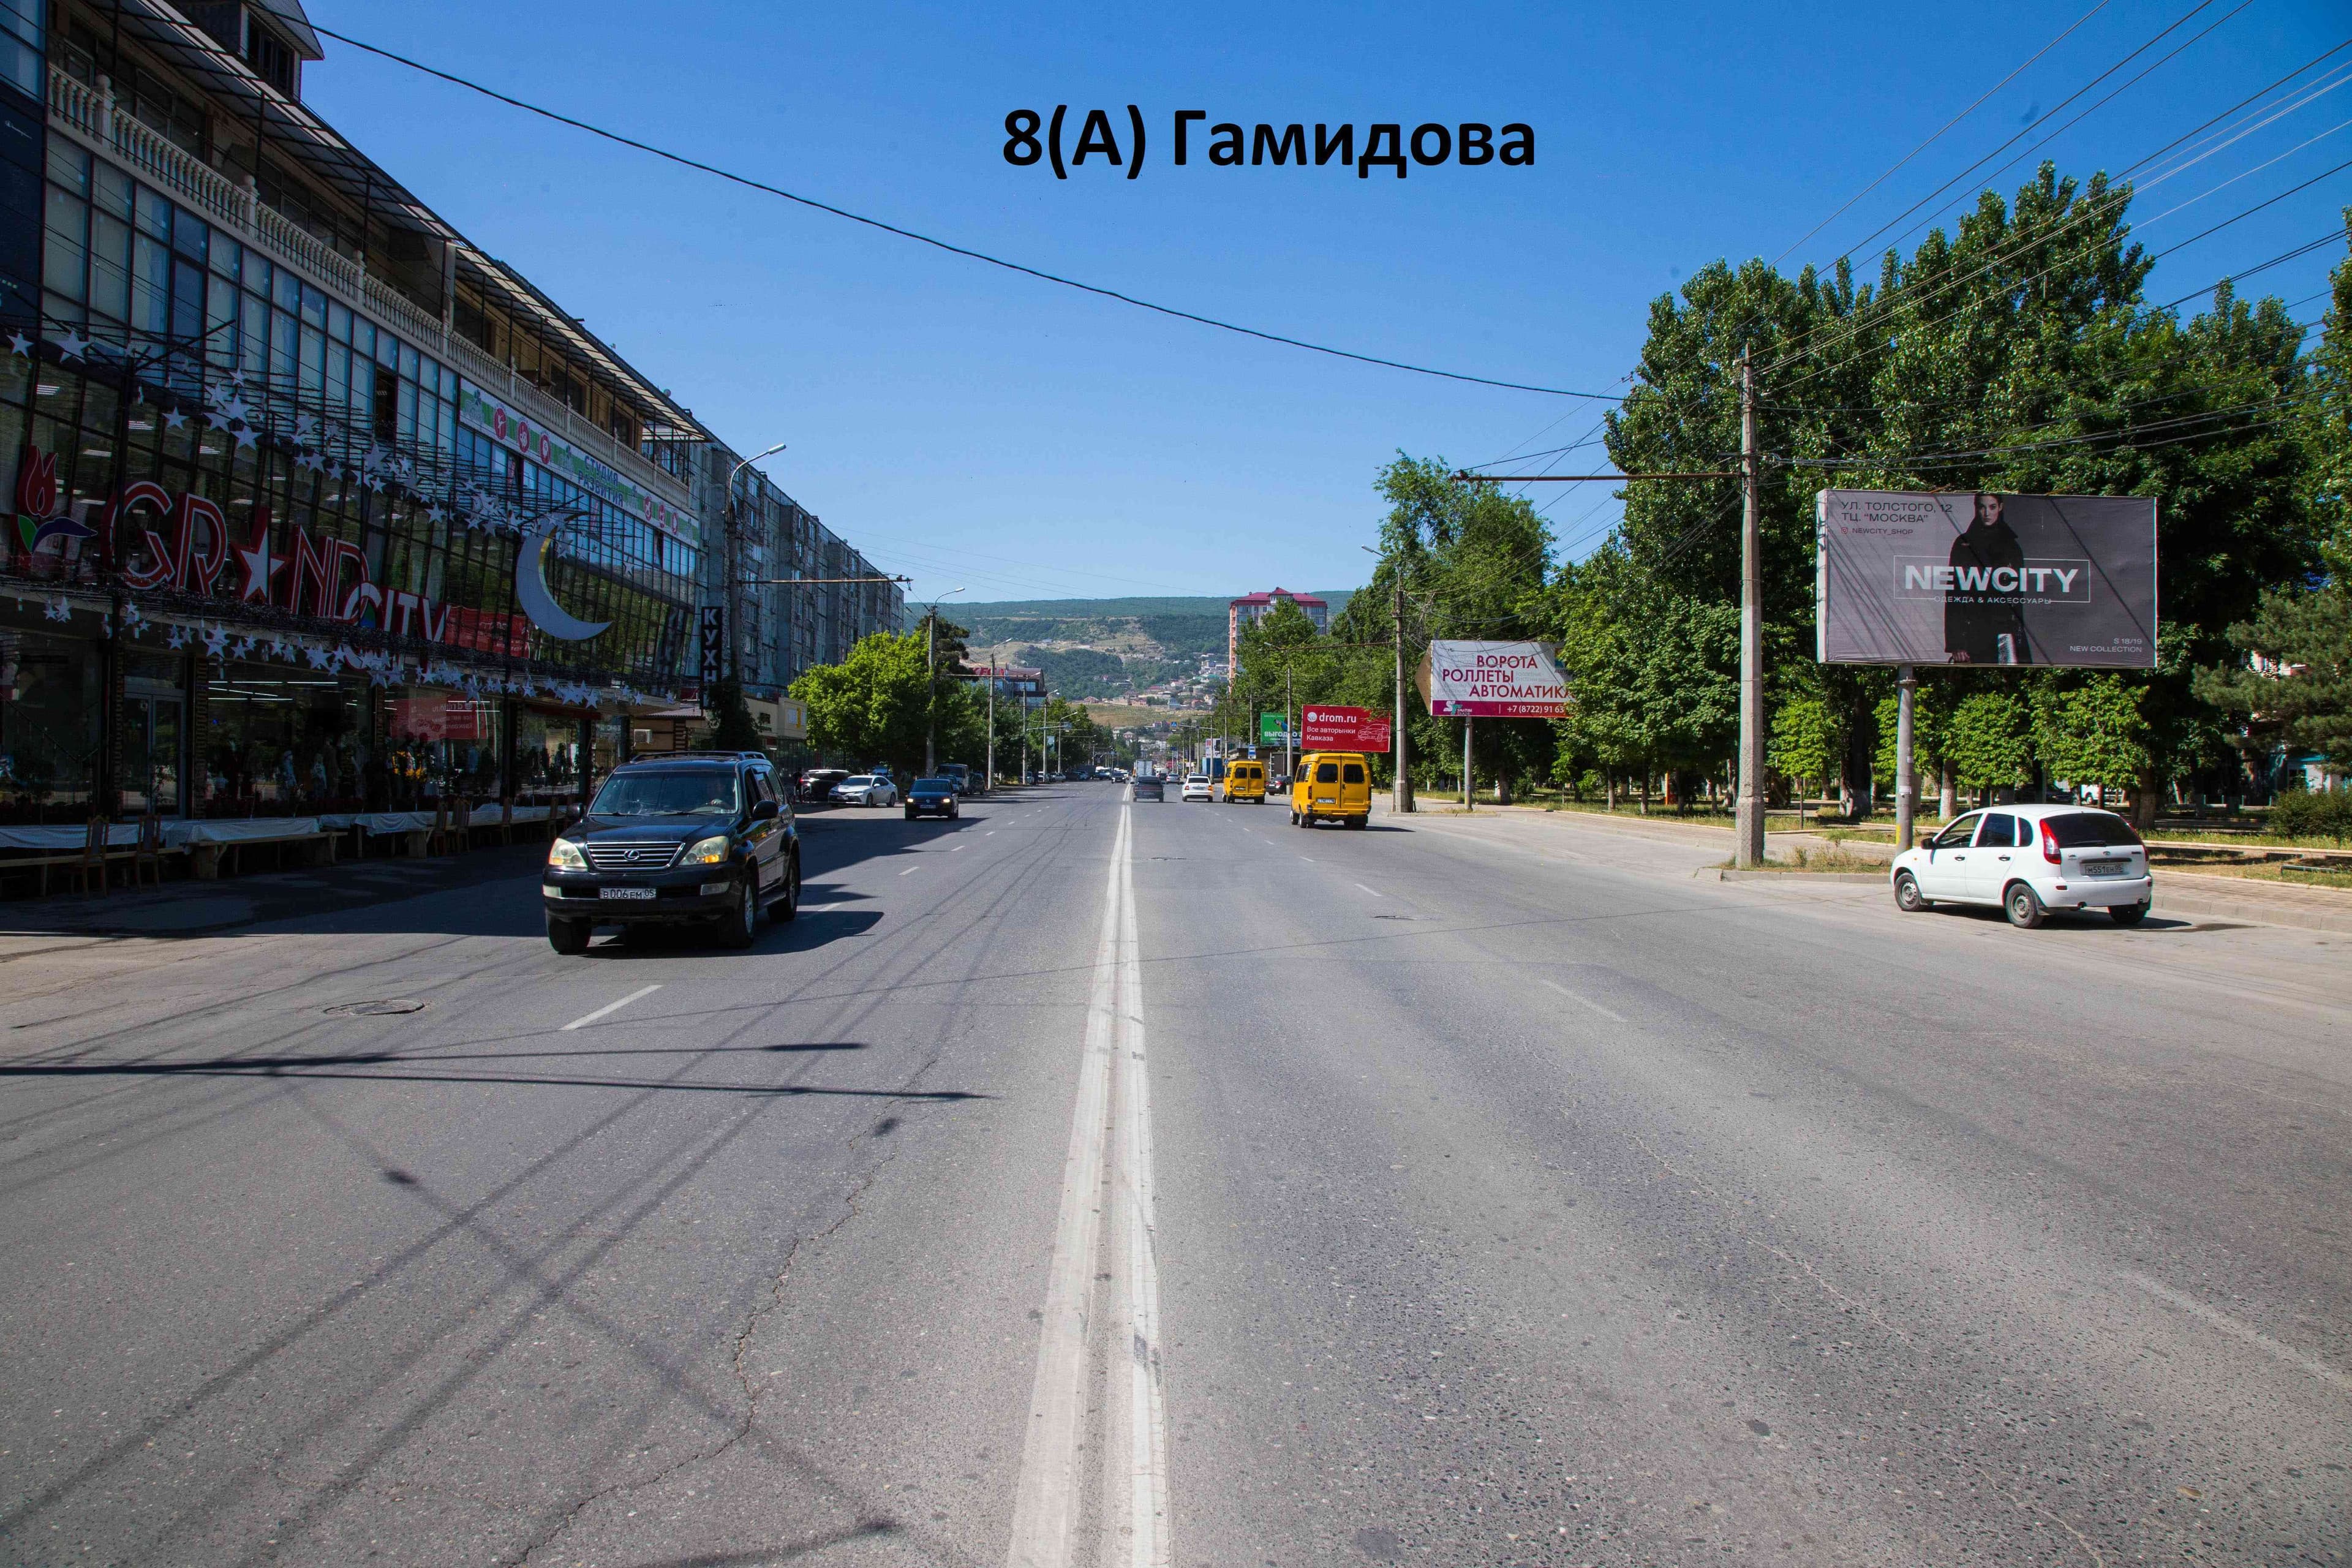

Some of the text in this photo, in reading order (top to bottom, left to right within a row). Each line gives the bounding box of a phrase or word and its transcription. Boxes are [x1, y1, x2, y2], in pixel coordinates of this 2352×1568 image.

[585, 455, 618, 486] СТУДИЯ
[578, 470, 623, 507] РАЗВИТИЯ
[1841, 502, 1953, 513] УЛ. ТОЛСТОГО, 12
[1841, 513, 1861, 522] ТЦ.
[1905, 565, 2078, 592] NEWCITY
[1477, 655, 1538, 669] ВОРОТА
[1442, 669, 1513, 682] РОЛЛЕТЫ
[1519, 705, 1542, 714] (8722)
[1319, 712, 1357, 723] drom.ru
